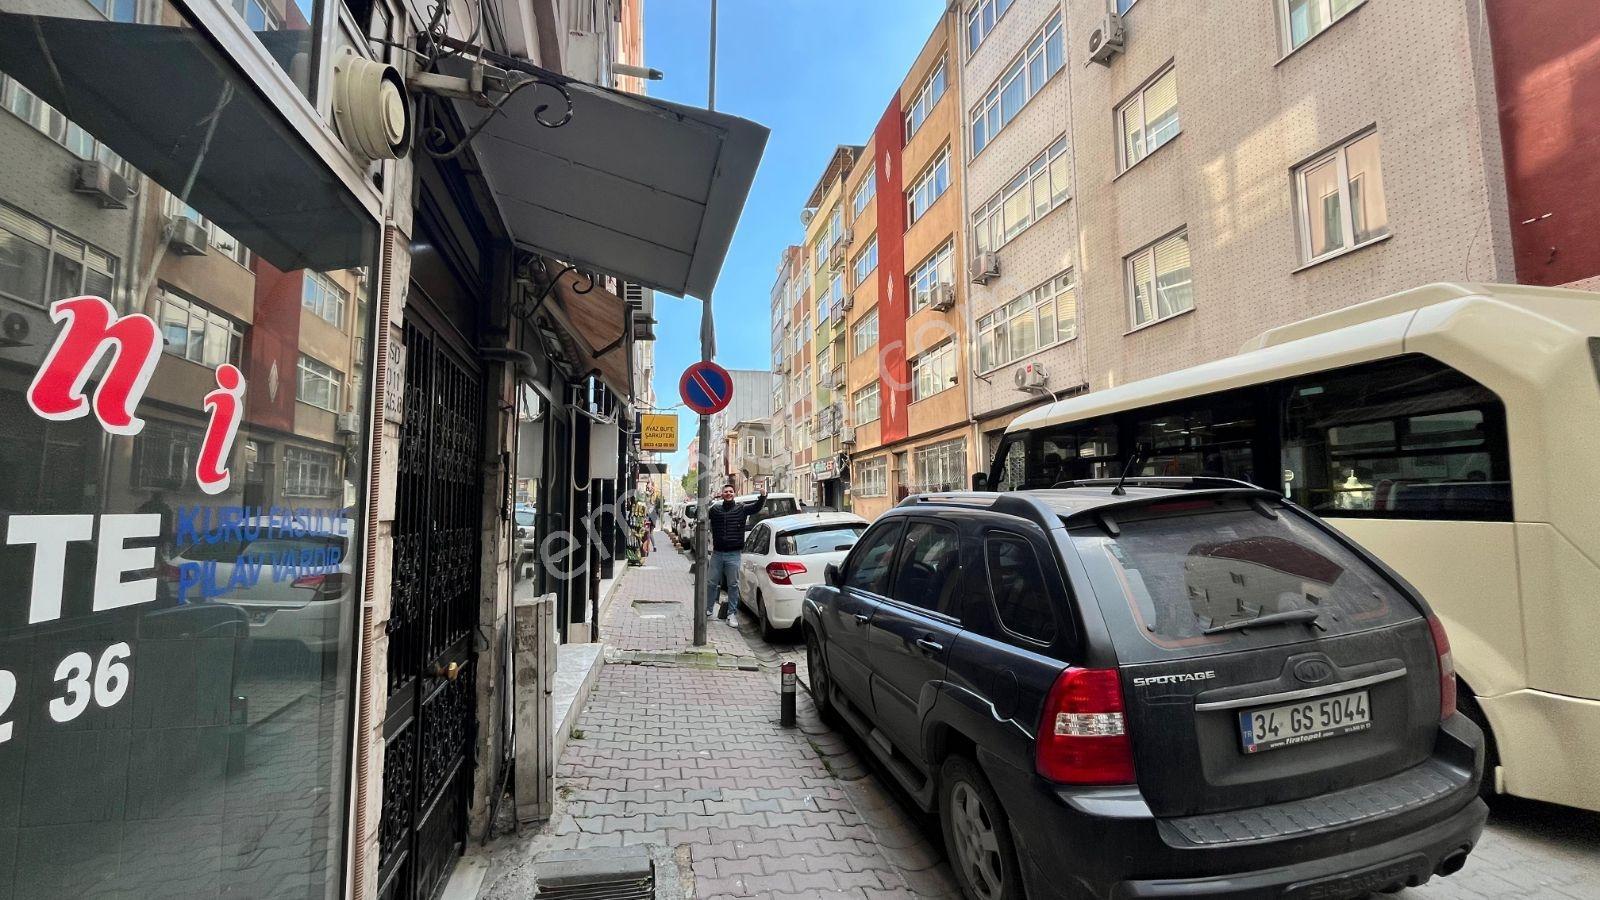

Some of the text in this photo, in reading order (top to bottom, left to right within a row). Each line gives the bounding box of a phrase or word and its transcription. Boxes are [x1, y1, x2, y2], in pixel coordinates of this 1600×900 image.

[176, 504, 348, 546] KURU FASULYE
[6, 514, 161, 624] TE
[49, 641, 131, 723] 36
[1133, 670, 1216, 687] SPORTAGE
[1243, 695, 1366, 740] TR 34 GS 5044
